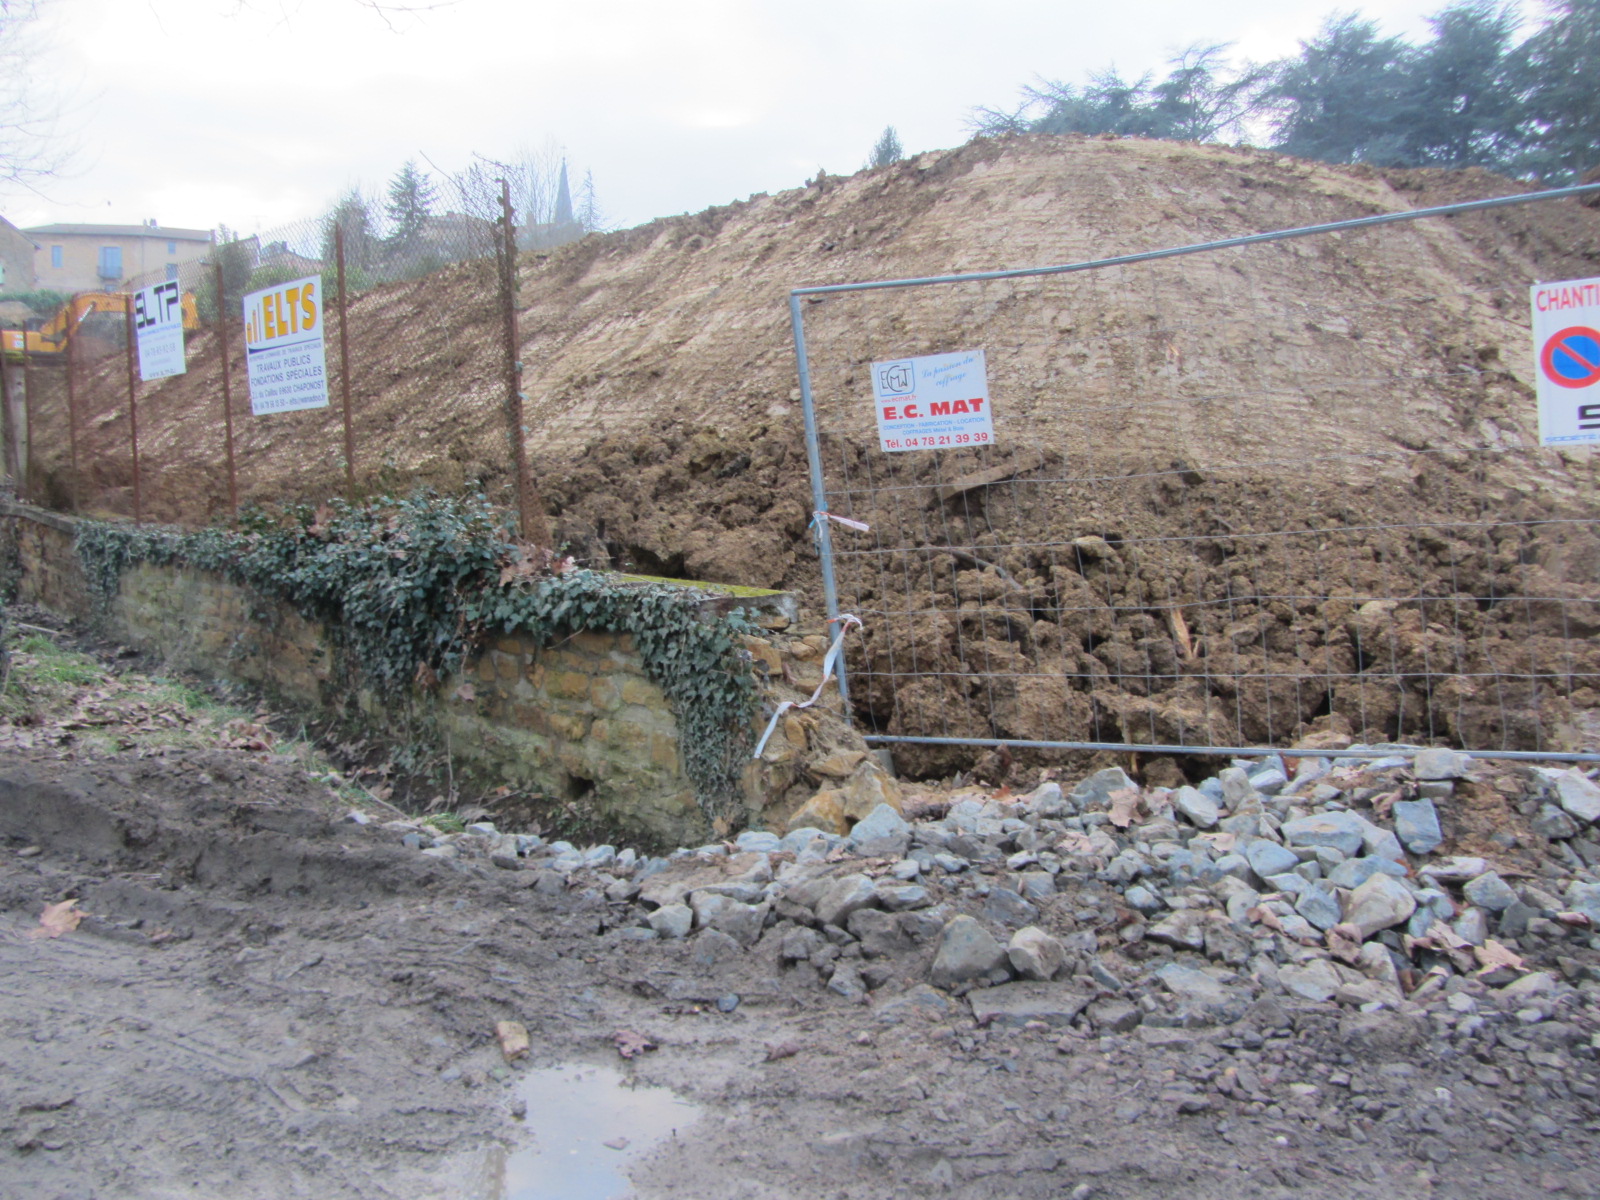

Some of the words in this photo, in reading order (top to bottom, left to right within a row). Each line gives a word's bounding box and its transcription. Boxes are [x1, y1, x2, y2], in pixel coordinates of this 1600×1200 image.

[262, 283, 317, 340] ELTS
[257, 360, 281, 373] TRAVAUX
[284, 354, 311, 368] PUBLICS
[251, 373, 284, 387] FONDATIONS
[293, 380, 324, 393] CHAPONOST
[883, 404, 924, 421] E.C.
[930, 398, 984, 417] MAT
[883, 423, 915, 431] CONCEPTION
[919, 420, 953, 428] FABRICATION
[957, 417, 985, 425] LOCATION
[902, 428, 933, 436] COFFRAGES
[885, 439, 903, 449] Tél.
[905, 438, 919, 447] 04
[922, 436, 936, 446] 78
[938, 435, 951, 445] 21
[955, 433, 970, 444] 39
[974, 432, 988, 442] 39
